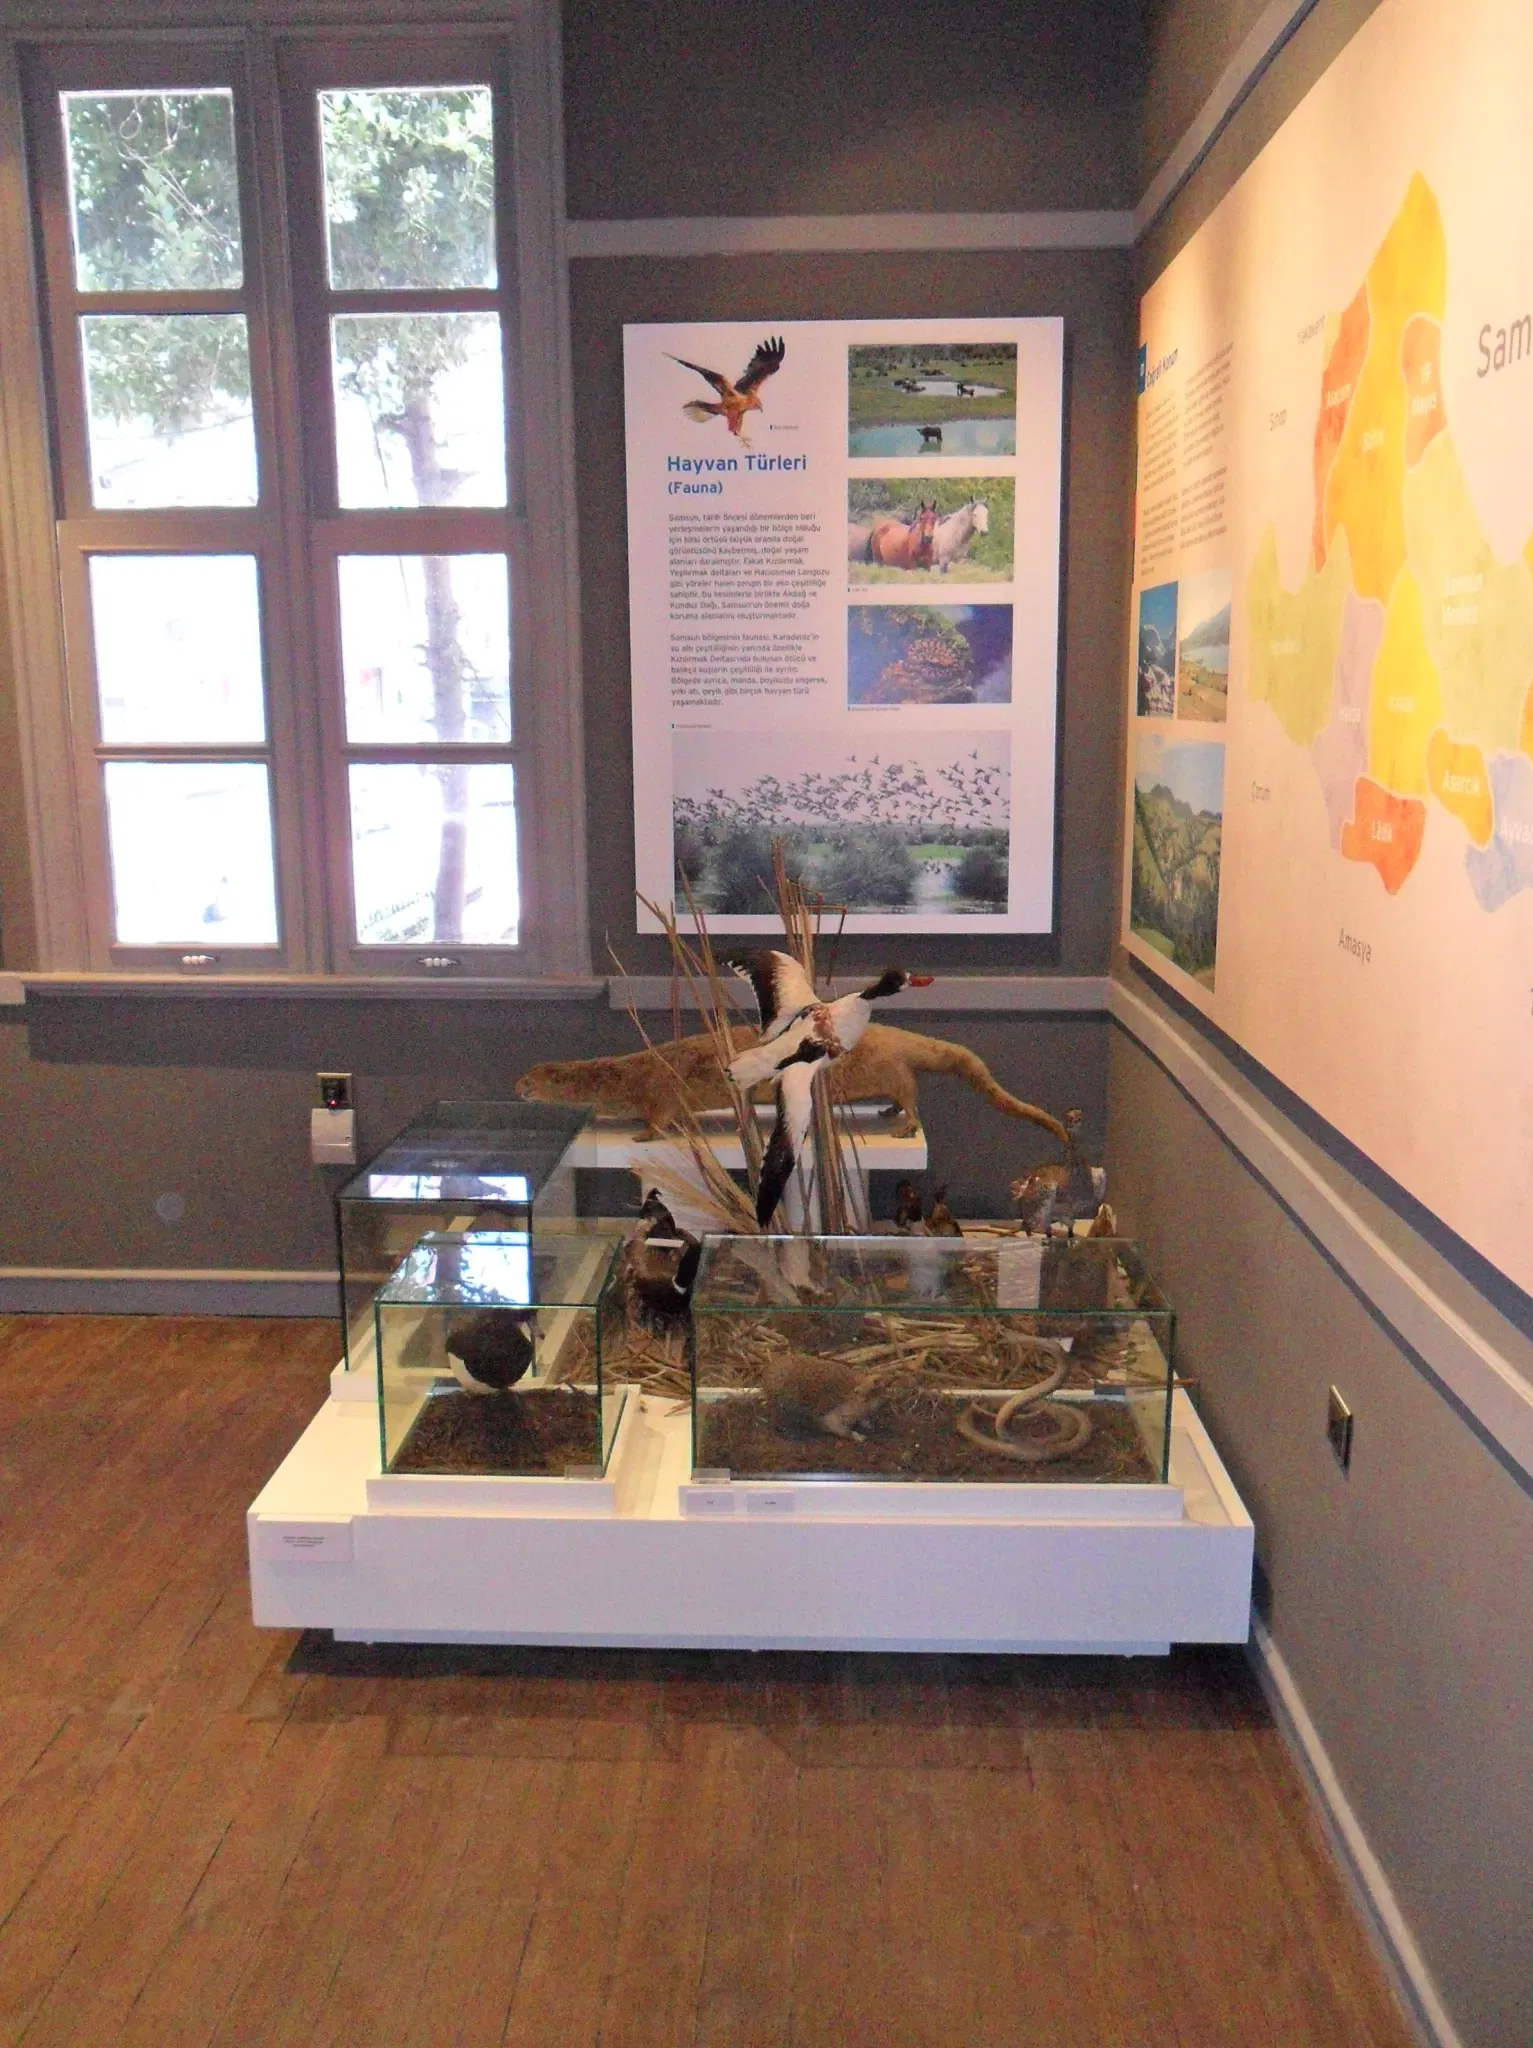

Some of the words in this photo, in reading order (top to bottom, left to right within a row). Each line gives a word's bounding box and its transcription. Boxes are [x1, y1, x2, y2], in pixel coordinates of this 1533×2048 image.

[1477, 315, 1533, 378] Sam
[667, 455, 738, 475] Hayvan
[745, 454, 807, 470] Türleri
[668, 481, 723, 495] (Fauna)
[1338, 927, 1371, 965] Amasya
